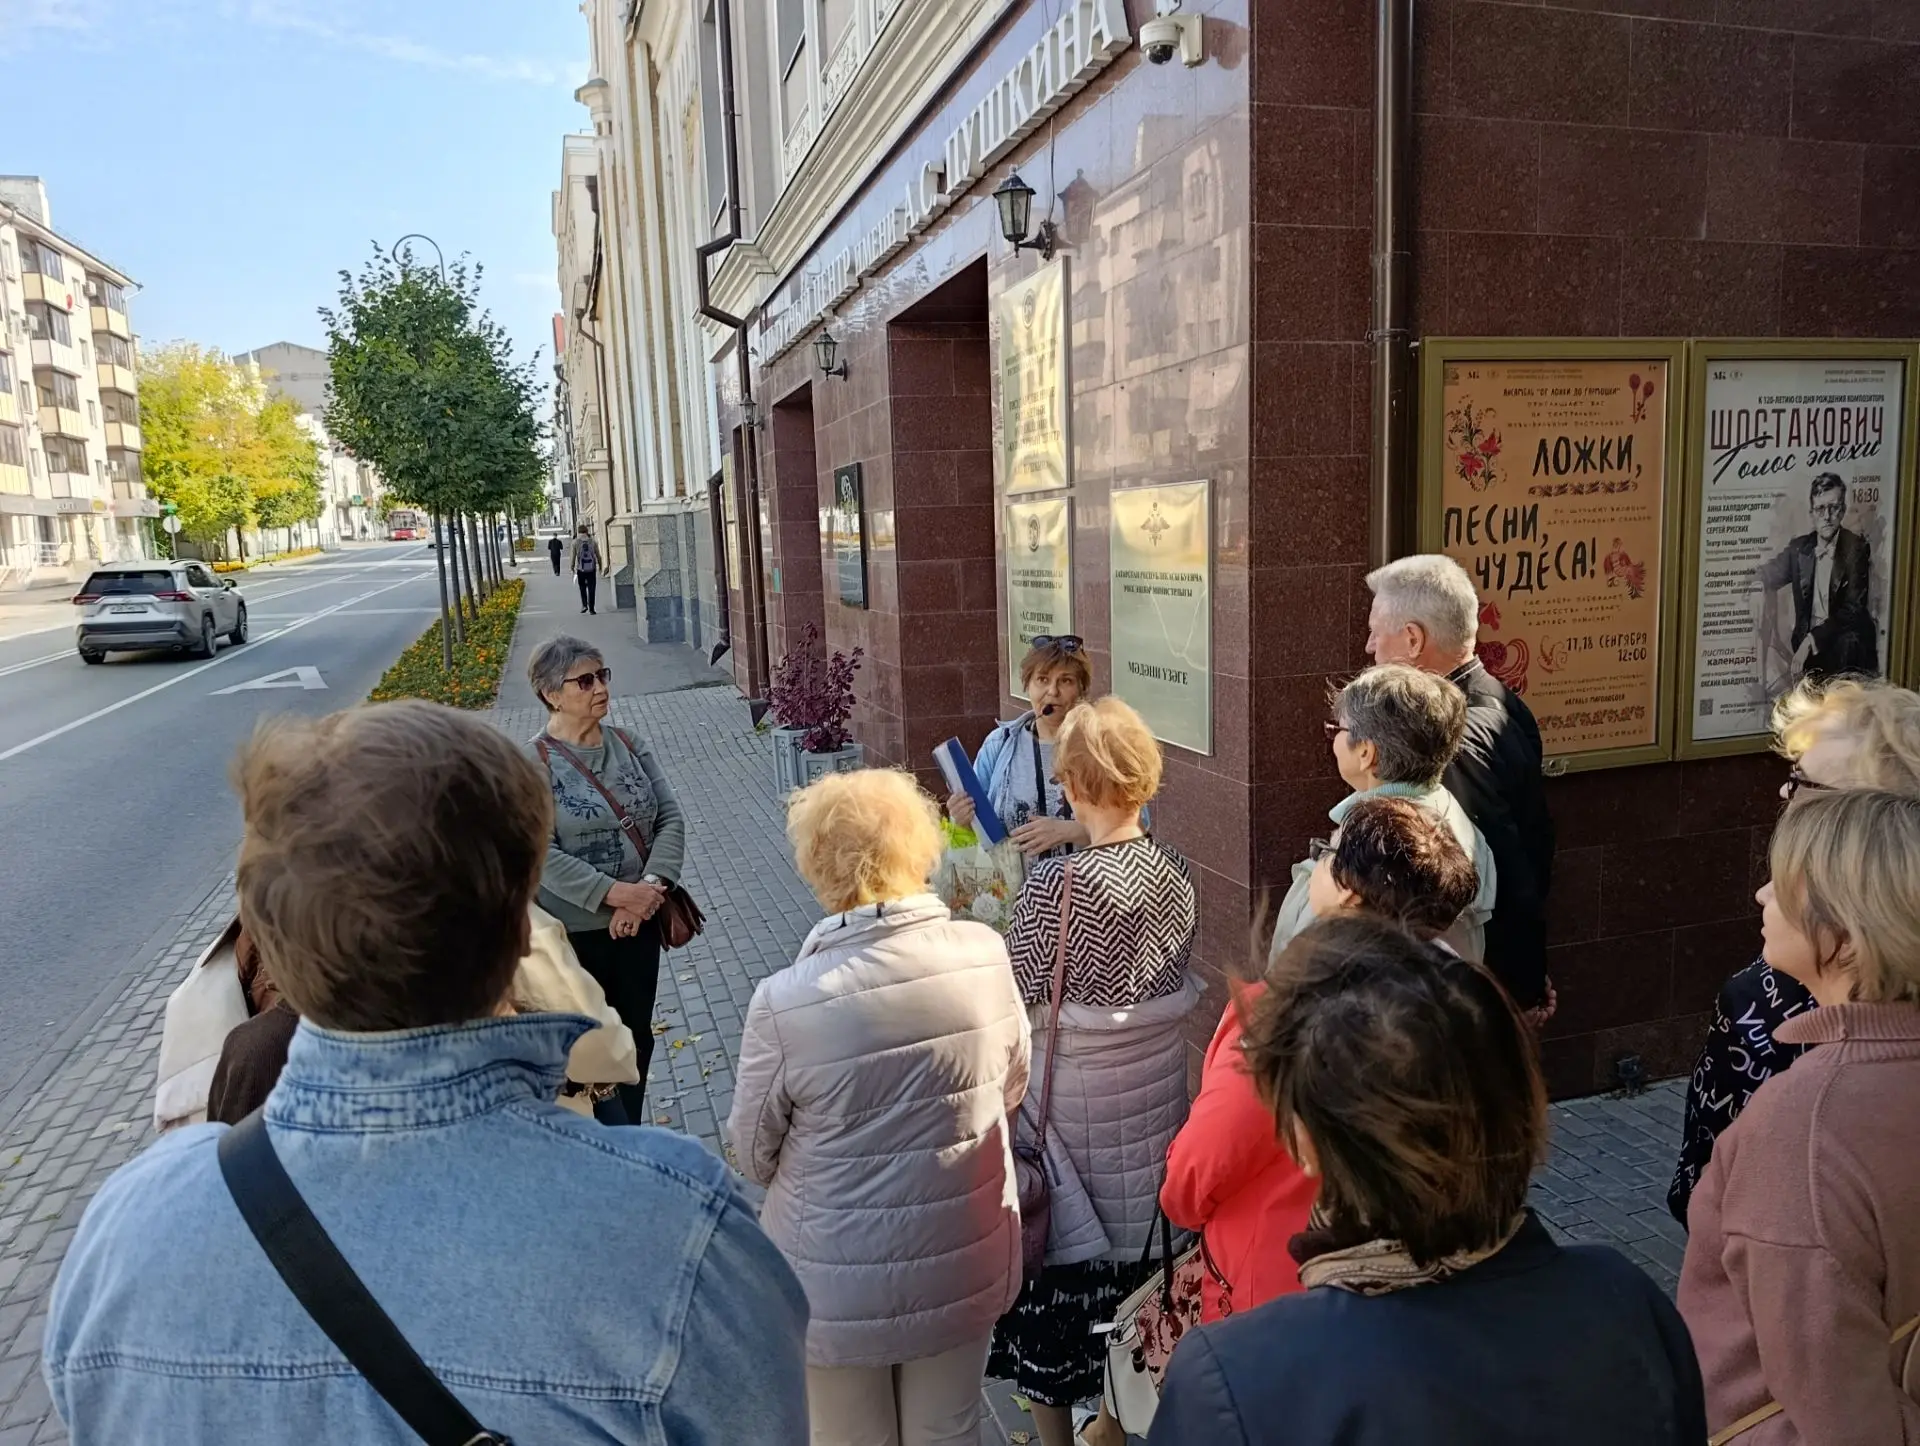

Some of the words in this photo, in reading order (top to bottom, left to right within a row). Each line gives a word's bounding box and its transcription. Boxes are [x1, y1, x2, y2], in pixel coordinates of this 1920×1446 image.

[854, 208, 899, 278] ИМЕНИ
[944, 0, 1114, 195] ПУШКИНА
[1551, 388, 1571, 397] ЛОЖКИ
[1574, 388, 1583, 397] ДО
[1764, 394, 1794, 404] 120-ЛЕТИЮ
[1795, 395, 1802, 404] СО
[1803, 394, 1815, 405] ДНЯ
[1816, 393, 1846, 404] РОЖДЕНИЯ
[1848, 393, 1884, 403] КОМПОЗИТОРА
[1711, 405, 1884, 451] ШОСТАКОВИЧ
[1532, 434, 1642, 478] ЛОЖКИ,
[1713, 436, 1797, 485] Голос
[1806, 441, 1882, 468] эпохи
[1852, 487, 1879, 503] 18:30
[1707, 504, 1721, 512] АННА
[1443, 503, 1549, 549] ПЕСНИ,
[1707, 514, 1733, 524] ДМИТРИЙ
[1734, 514, 1751, 522] БОСОВ
[1706, 525, 1725, 534] СЕРГЕЙ
[1726, 525, 1749, 533] РУССКИХ
[1475, 537, 1597, 600] ЧУДЕСА!
[1705, 569, 1729, 578] Сводный
[1599, 632, 1648, 649] СЕНТЯБРЯ
[1617, 647, 1648, 663] 12:00
[1702, 648, 1735, 658] листая
[1707, 656, 1757, 667] календарь
[1128, 661, 1161, 680] МӘДӘНИ
